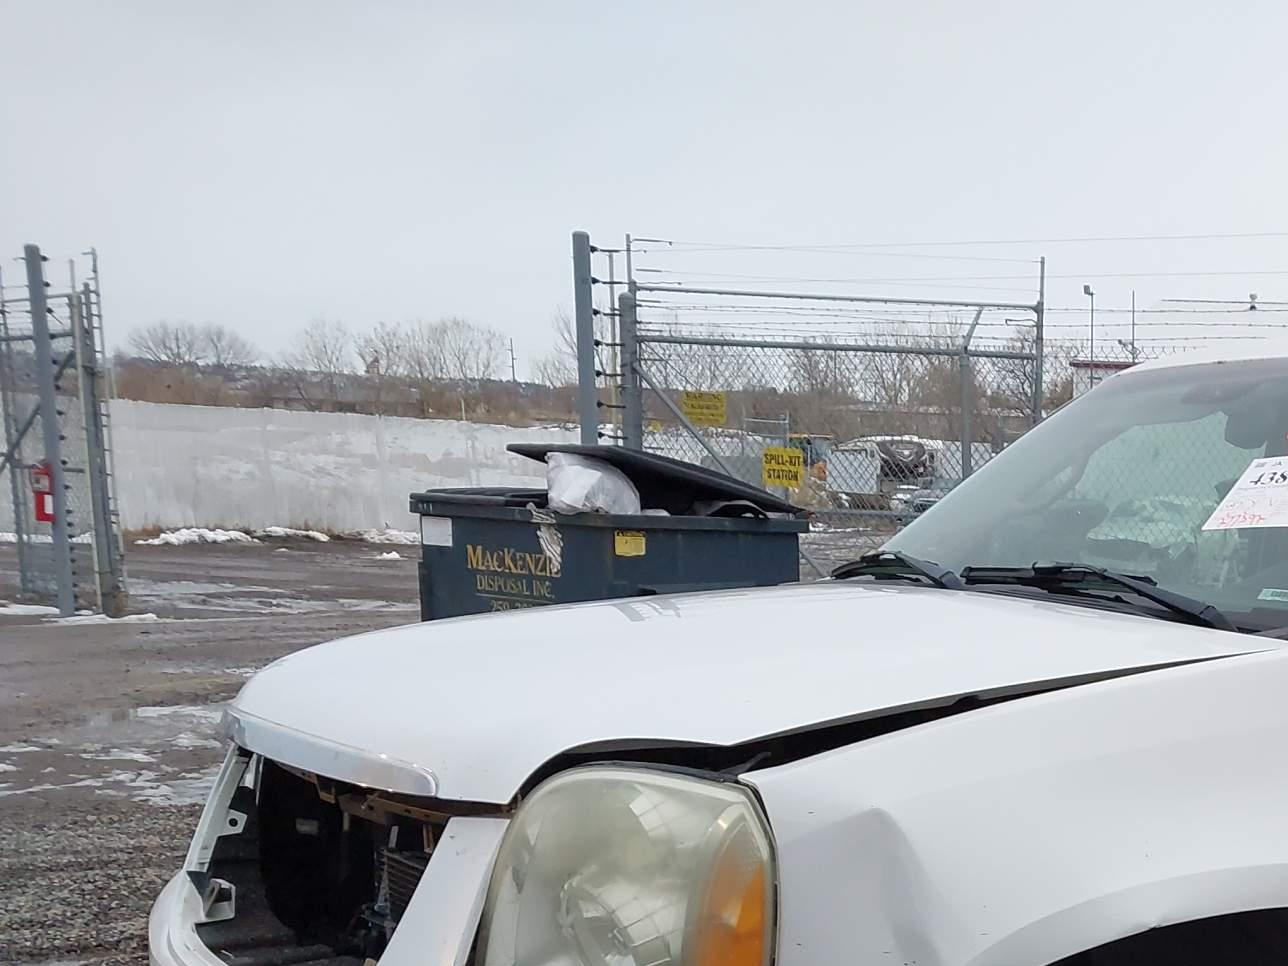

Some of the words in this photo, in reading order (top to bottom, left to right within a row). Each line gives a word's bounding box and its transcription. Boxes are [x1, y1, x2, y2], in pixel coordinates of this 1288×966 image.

[764, 453, 801, 467] SPILL-KIT
[767, 468, 799, 481] STATION
[476, 574, 530, 595] DISPOSAL
[532, 579, 555, 598] INC.
